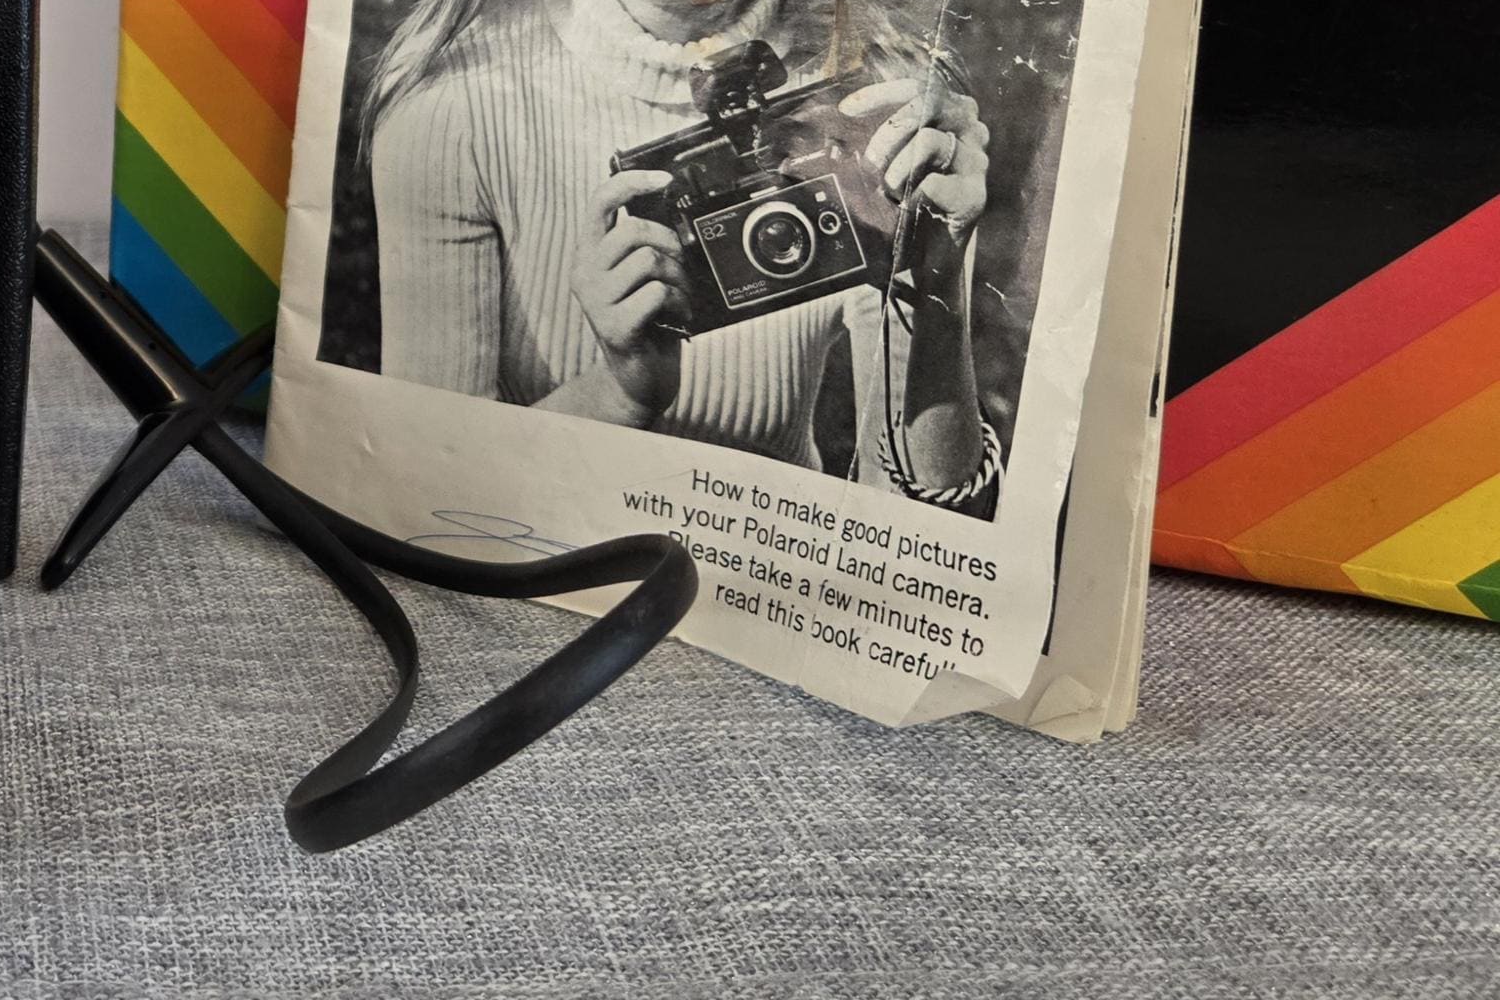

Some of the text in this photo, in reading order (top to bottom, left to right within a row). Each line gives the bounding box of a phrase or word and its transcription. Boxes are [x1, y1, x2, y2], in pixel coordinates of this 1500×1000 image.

[702, 223, 727, 240] 82
[623, 491, 989, 619] with your Polaroid Land camera.
[692, 469, 997, 581] How to make good pictures
[716, 584, 761, 615] read
[767, 599, 805, 632] this
[810, 613, 861, 654] book
[749, 555, 792, 590] take
[798, 578, 810, 596] a
[818, 579, 852, 611] few
[857, 599, 953, 647] minutes
[961, 628, 984, 657] to
